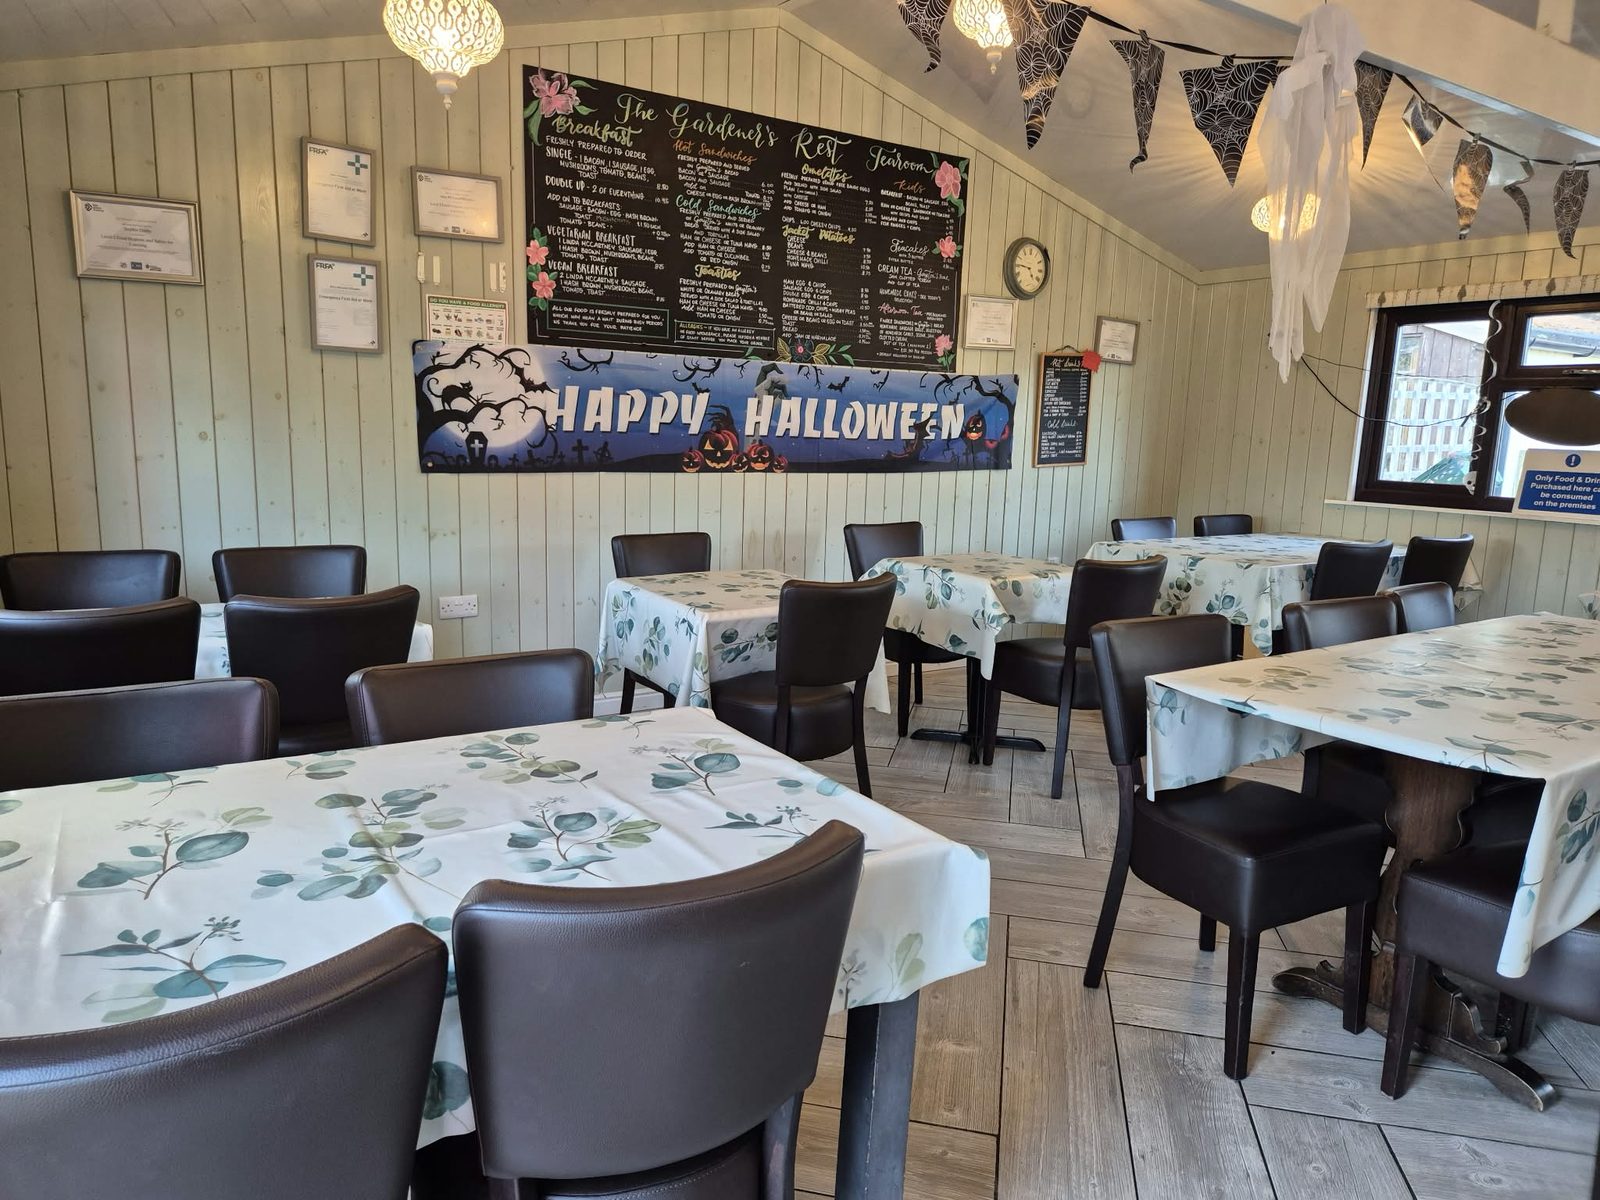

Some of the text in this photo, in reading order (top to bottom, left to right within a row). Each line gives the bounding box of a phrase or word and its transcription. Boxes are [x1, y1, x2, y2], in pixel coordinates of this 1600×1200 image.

[552, 116, 642, 148] Breakfast
[614, 93, 934, 173] The Gardener's Rest Tearoom
[546, 135, 647, 160] FRESHLY PREPARED ORDER
[546, 146, 572, 161] SINGLE
[672, 140, 758, 165] Hot Sandwiches
[578, 170, 597, 180] TOAST
[679, 174, 696, 182] BACON
[801, 163, 853, 183] Omelettes
[546, 175, 573, 189] DOUBLE
[576, 180, 584, 191] UP
[599, 186, 606, 195] OF
[609, 187, 645, 200] EVERYTHING
[894, 180, 926, 194] Kids
[548, 193, 570, 203] ADD ON
[559, 203, 582, 212] SAUSAGE
[588, 207, 606, 216] BACON
[676, 194, 762, 221] Cold Sandwiches
[560, 217, 582, 226] TOMATO
[547, 225, 591, 241] VEGETARIAN
[596, 231, 635, 247] BREAKFAST
[782, 224, 856, 245] Jacket Potatoes
[890, 238, 929, 256] Teacakes
[548, 260, 617, 277] VEGAN BREAKFAST
[694, 264, 741, 281] Toasties
[878, 264, 901, 275] CREAM
[902, 266, 913, 276] TEA
[550, 385, 967, 441] HAPPY HALLOWEEN
[1530, 482, 1572, 491] Purchased
